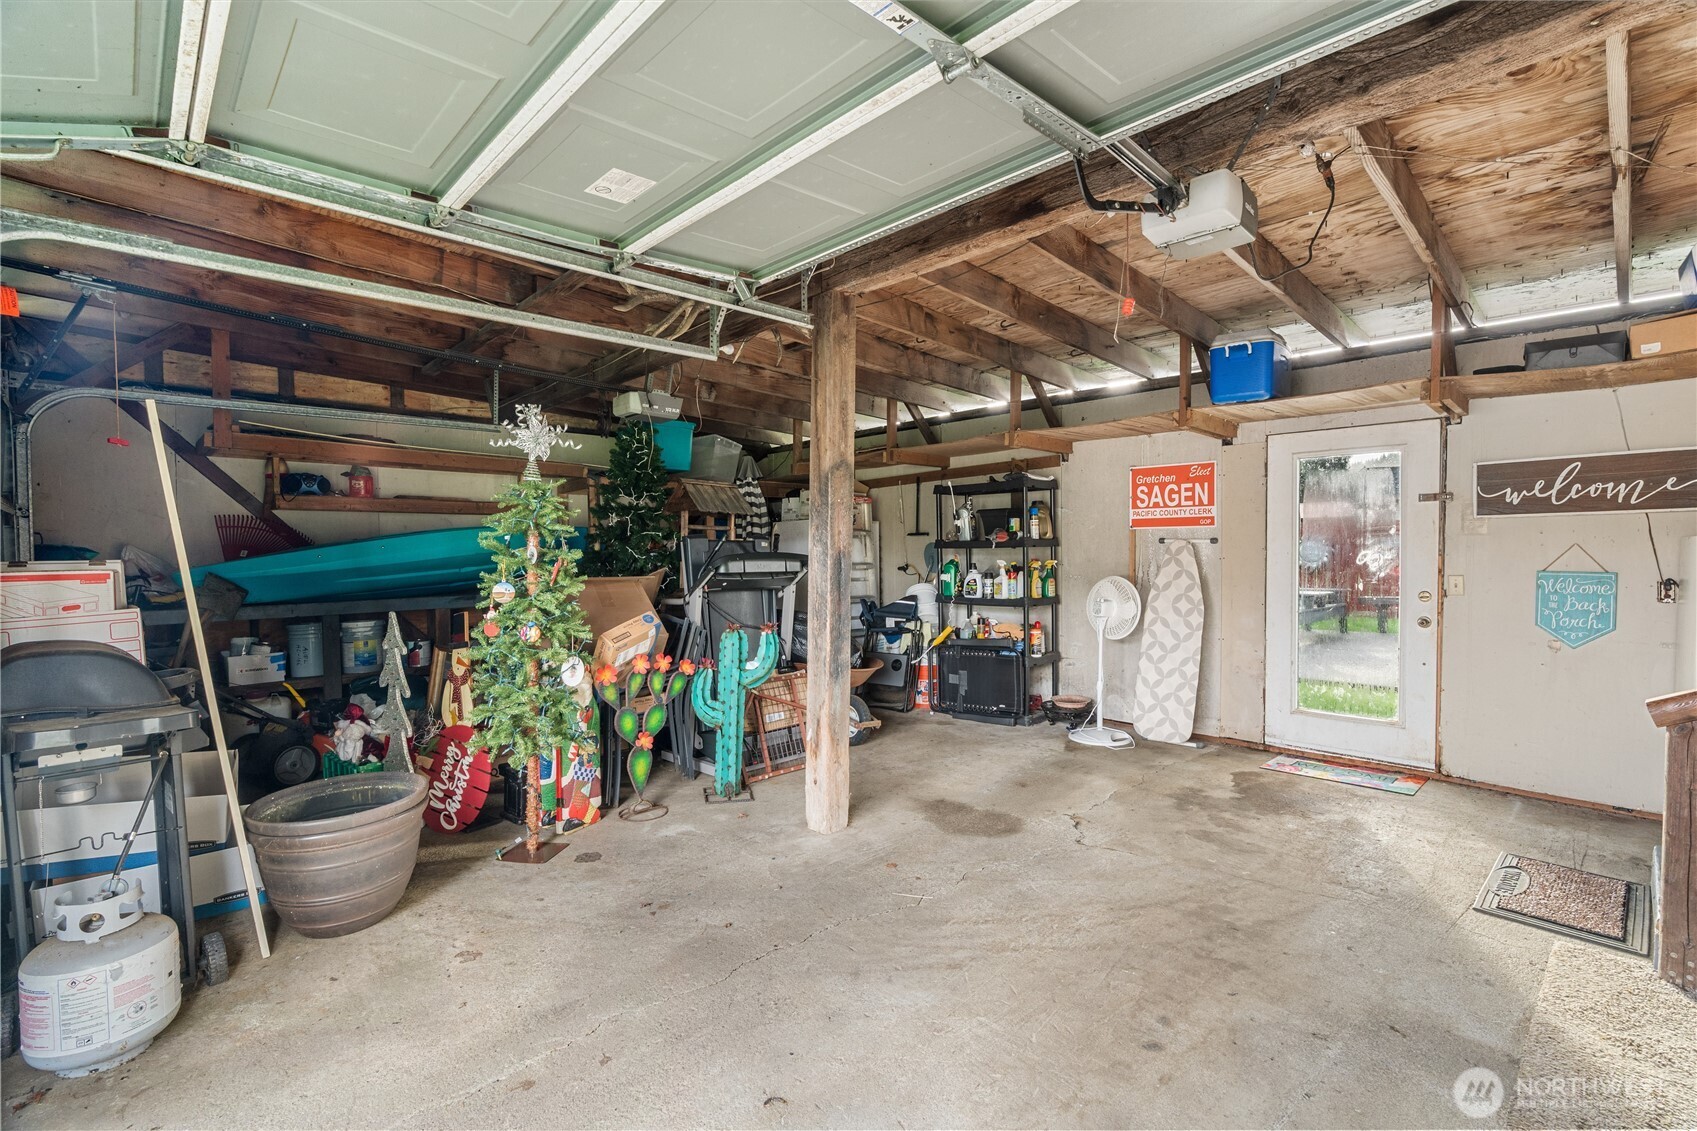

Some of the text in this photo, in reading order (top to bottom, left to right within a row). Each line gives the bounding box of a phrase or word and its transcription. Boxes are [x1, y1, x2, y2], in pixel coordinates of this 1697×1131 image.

[1136, 474, 1176, 484] Gretchen
[1189, 465, 1211, 477] Elect
[1478, 462, 1697, 505] welcome
[1136, 482, 1209, 508] SAGEN
[1159, 509, 1187, 517] COUNTY
[1188, 508, 1213, 516] CLERK
[1538, 577, 1615, 595] Welcome
[1549, 594, 1558, 602] TO
[1564, 595, 1610, 615] Back
[1542, 608, 1605, 629] Porch
[429, 741, 462, 809] Merry
[440, 738, 476, 830] Christm
